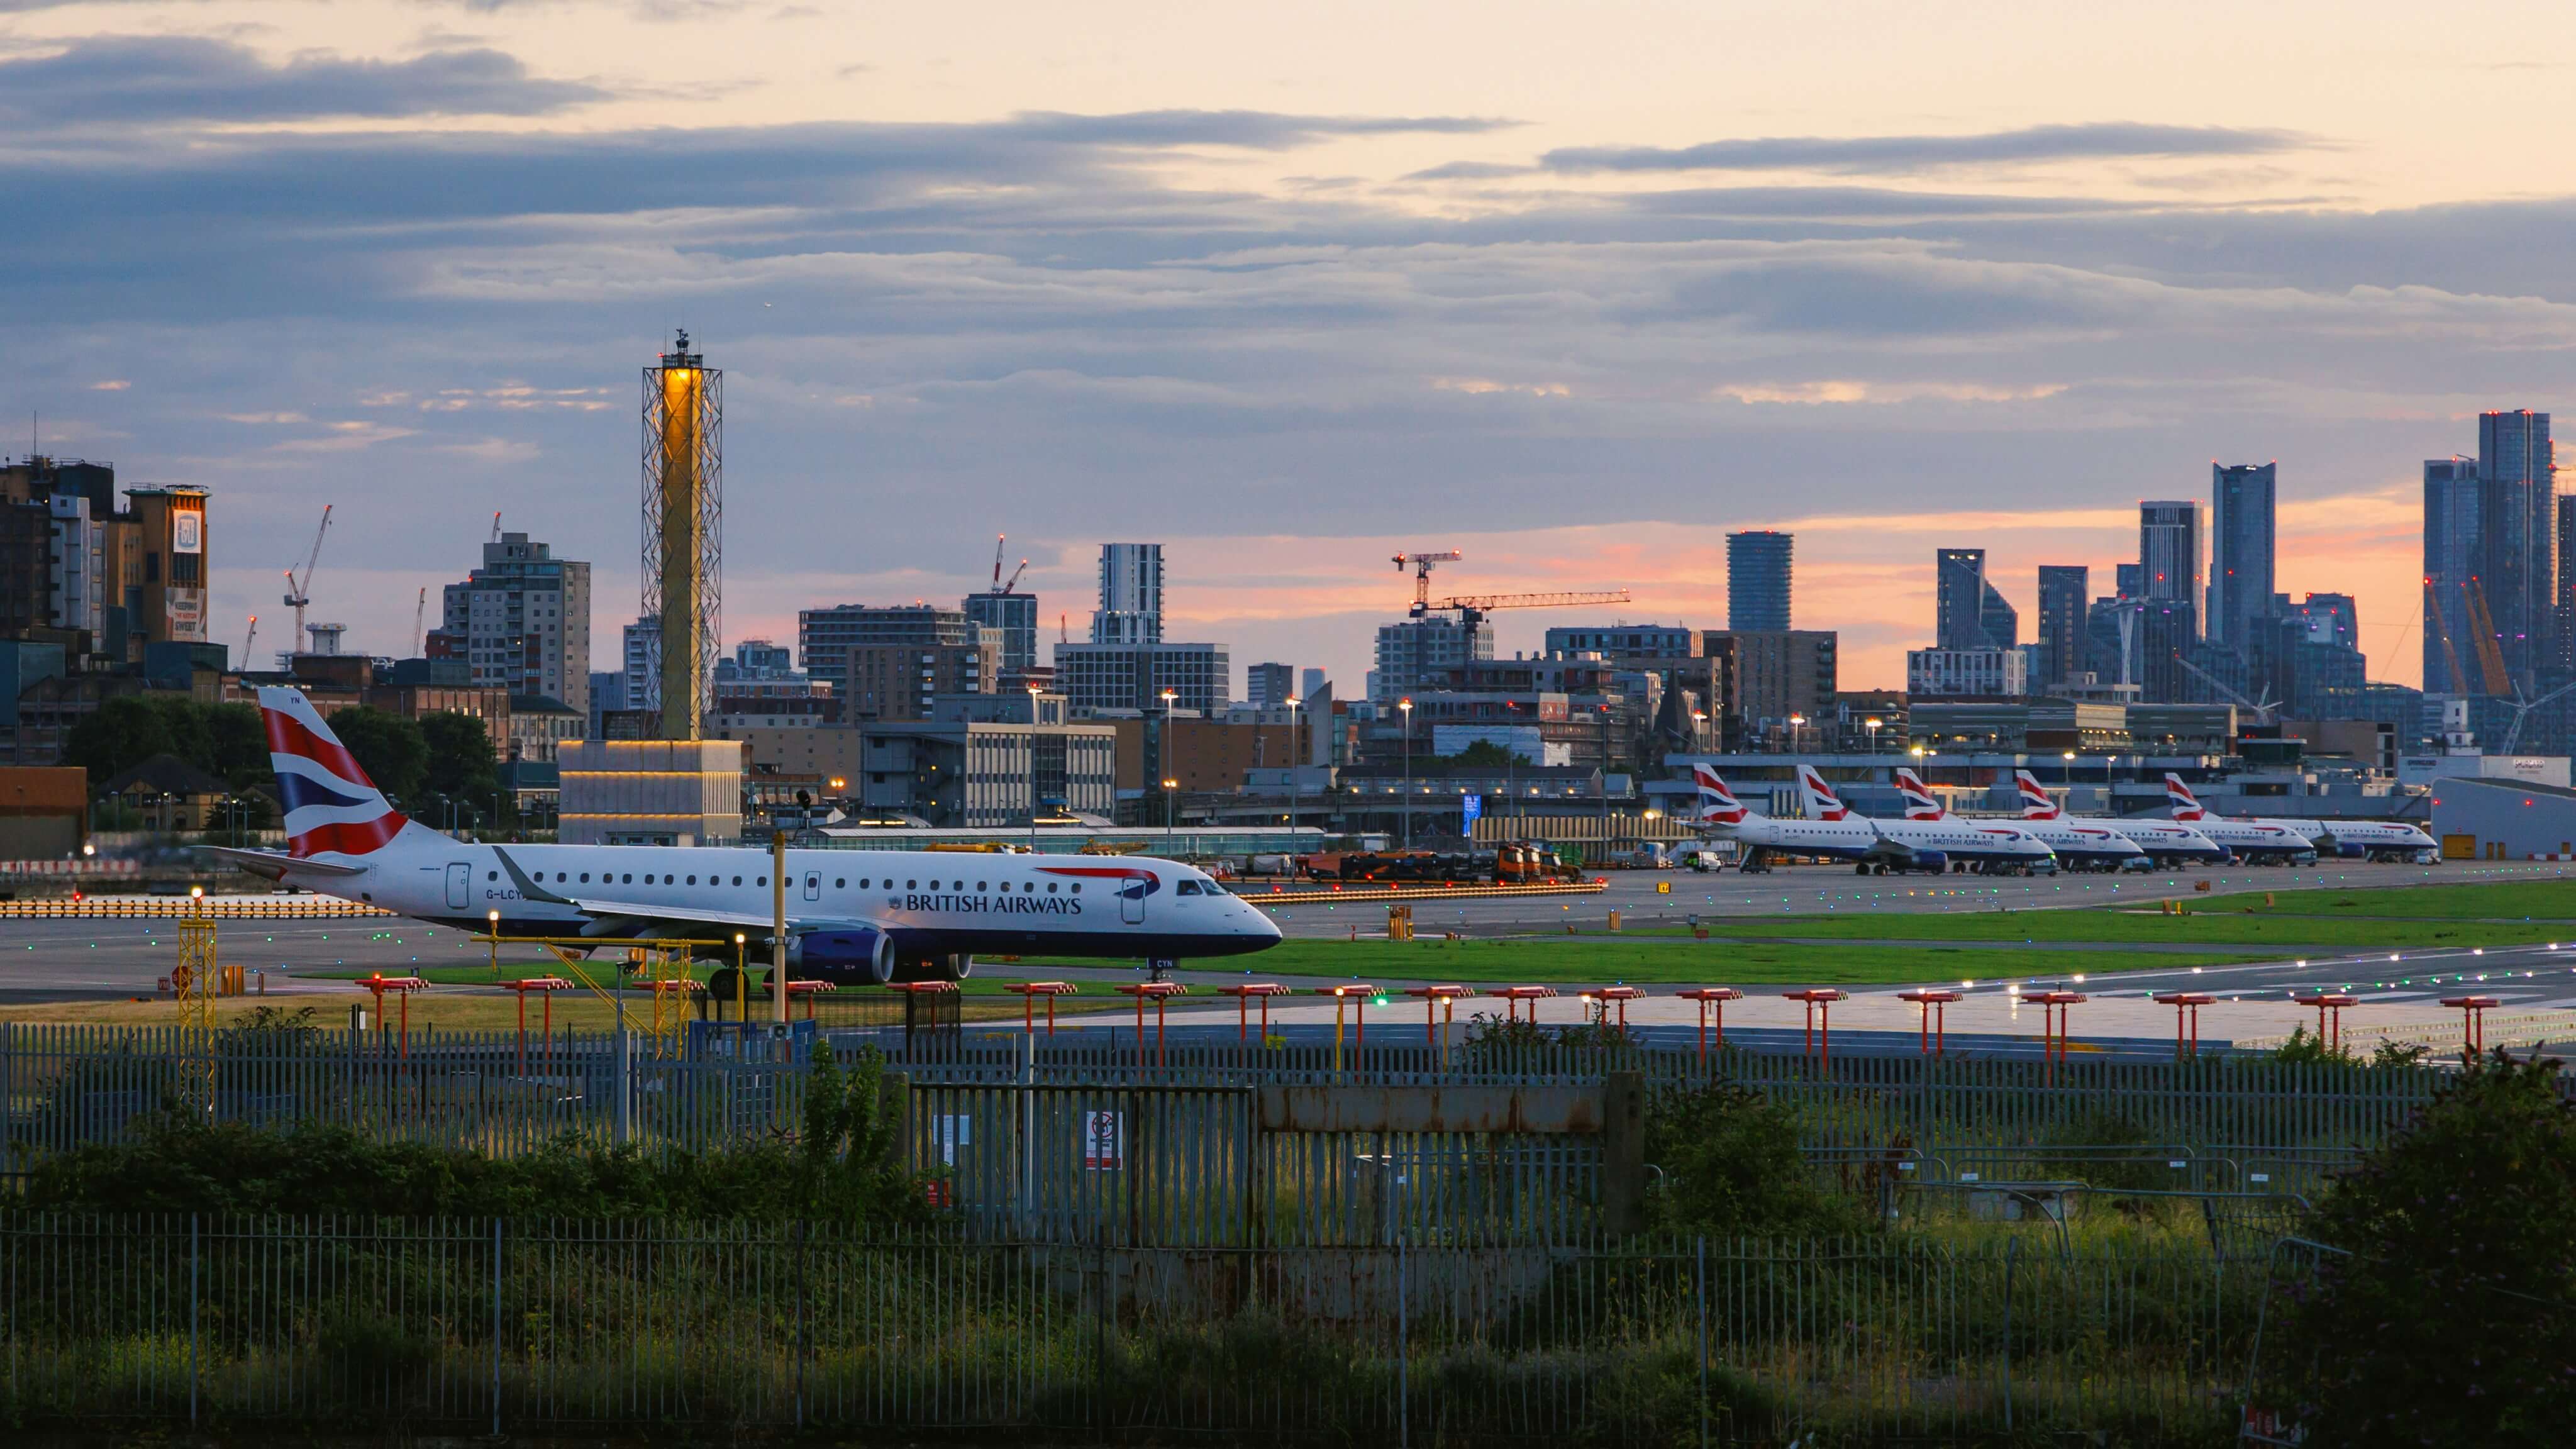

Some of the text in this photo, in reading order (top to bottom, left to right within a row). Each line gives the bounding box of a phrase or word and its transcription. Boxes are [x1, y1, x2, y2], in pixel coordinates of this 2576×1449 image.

[175, 621, 196, 631] SWEET
[487, 889, 523, 900] G-LCY
[907, 894, 1082, 914] BRITISH AIRWAYS
